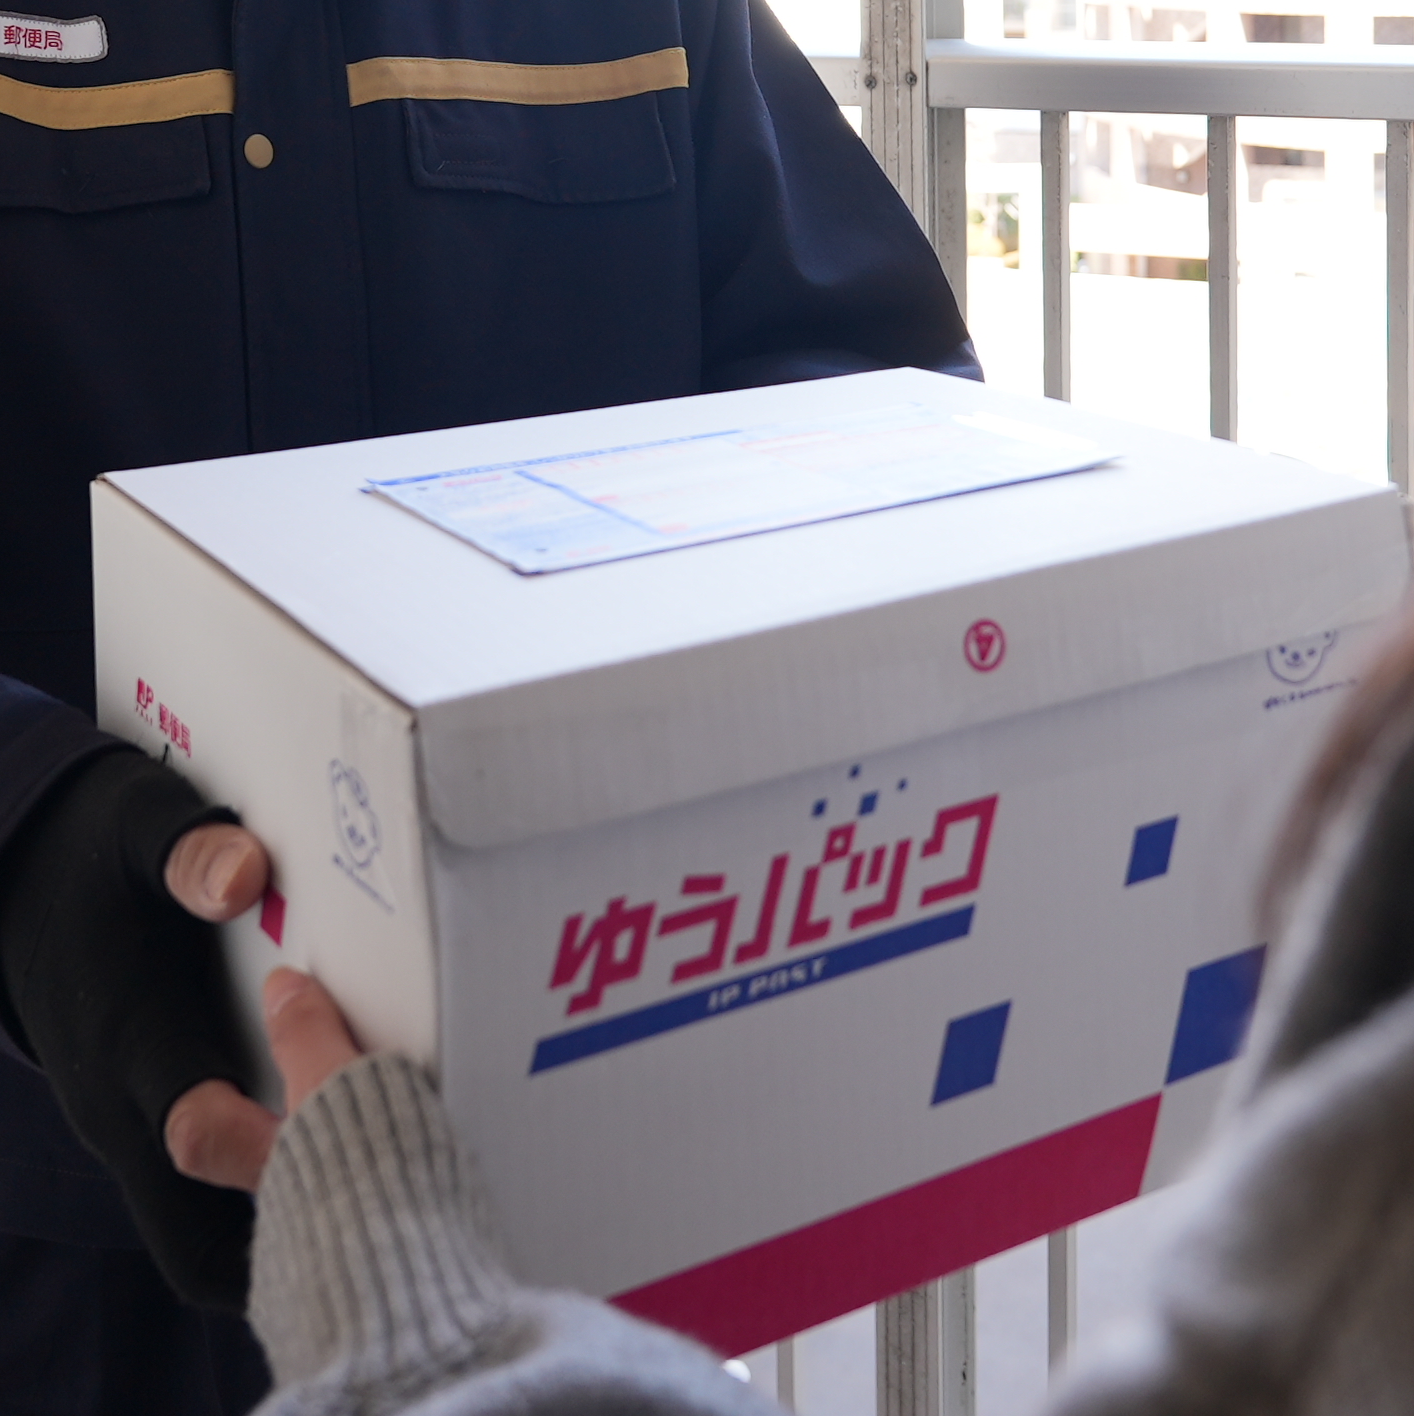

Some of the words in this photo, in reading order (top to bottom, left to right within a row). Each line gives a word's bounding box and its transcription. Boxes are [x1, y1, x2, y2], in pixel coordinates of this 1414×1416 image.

[3, 24, 63, 51] 郵便局
[548, 793, 1000, 1018] ゆうパック
